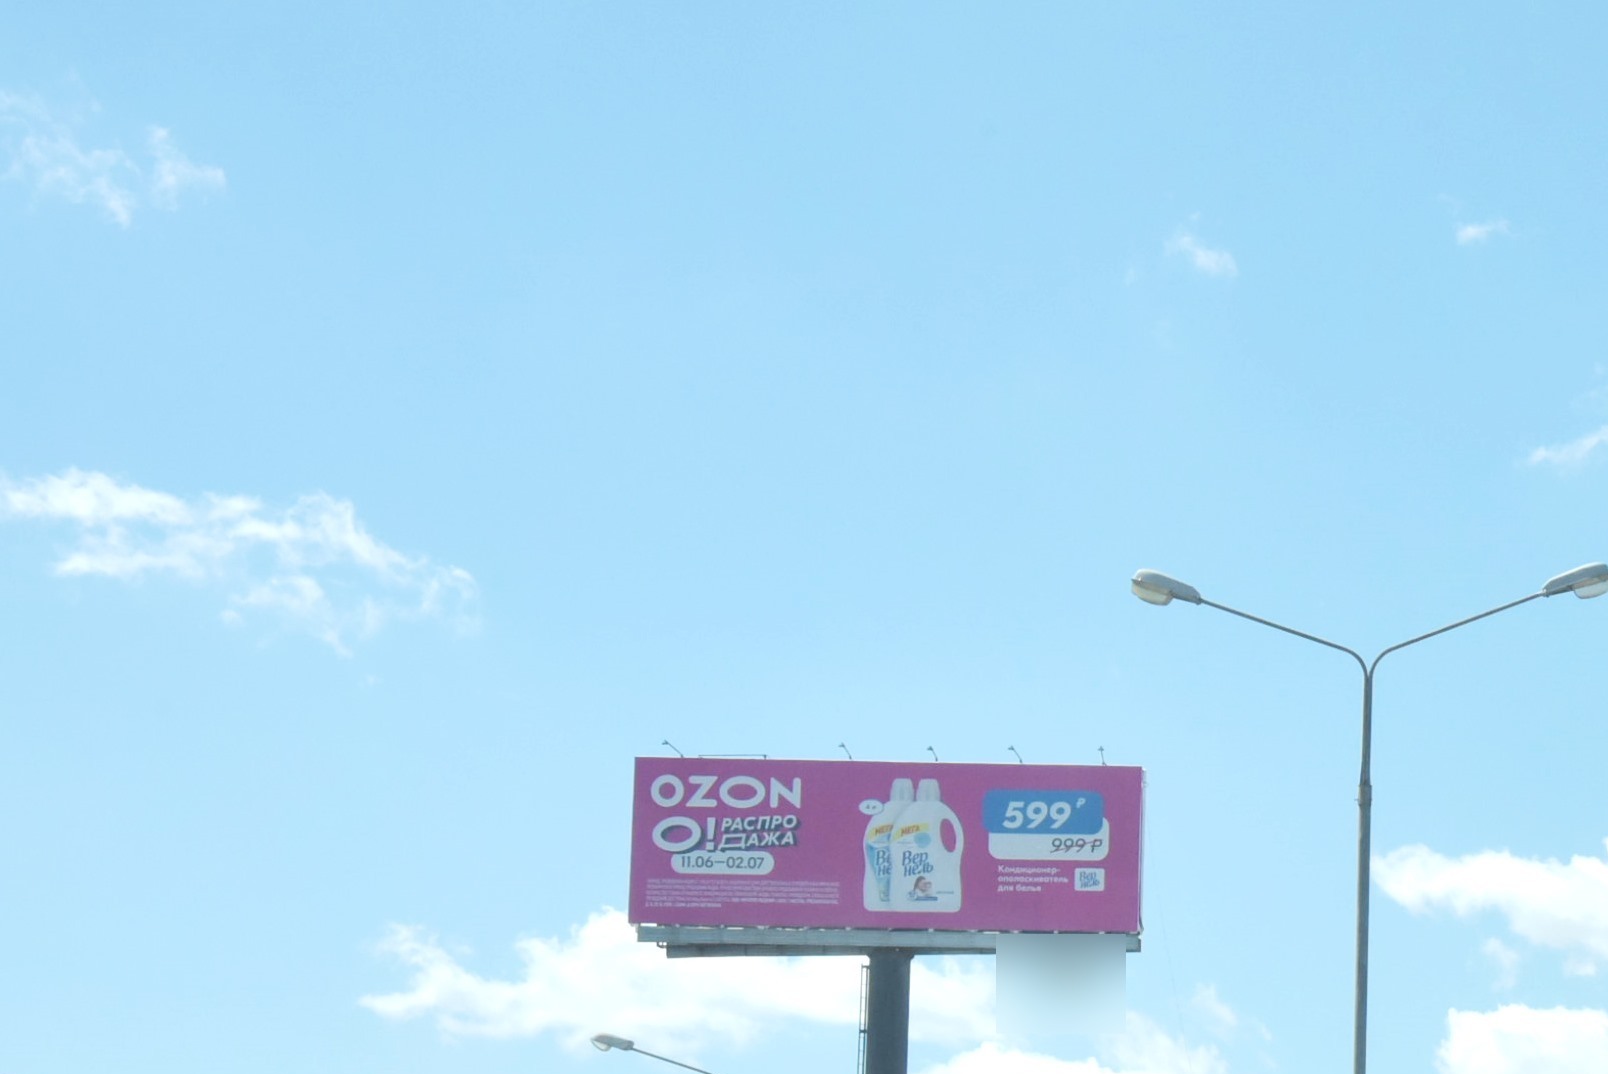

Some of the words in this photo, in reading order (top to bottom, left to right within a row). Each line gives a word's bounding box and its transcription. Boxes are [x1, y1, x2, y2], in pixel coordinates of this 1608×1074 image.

[650, 774, 802, 808] OZON
[721, 814, 798, 832] РАСПРО
[1002, 801, 1071, 829] 599
[718, 831, 795, 850] ДАЖА
[1051, 838, 1086, 853] 999
[902, 850, 928, 866] Вер
